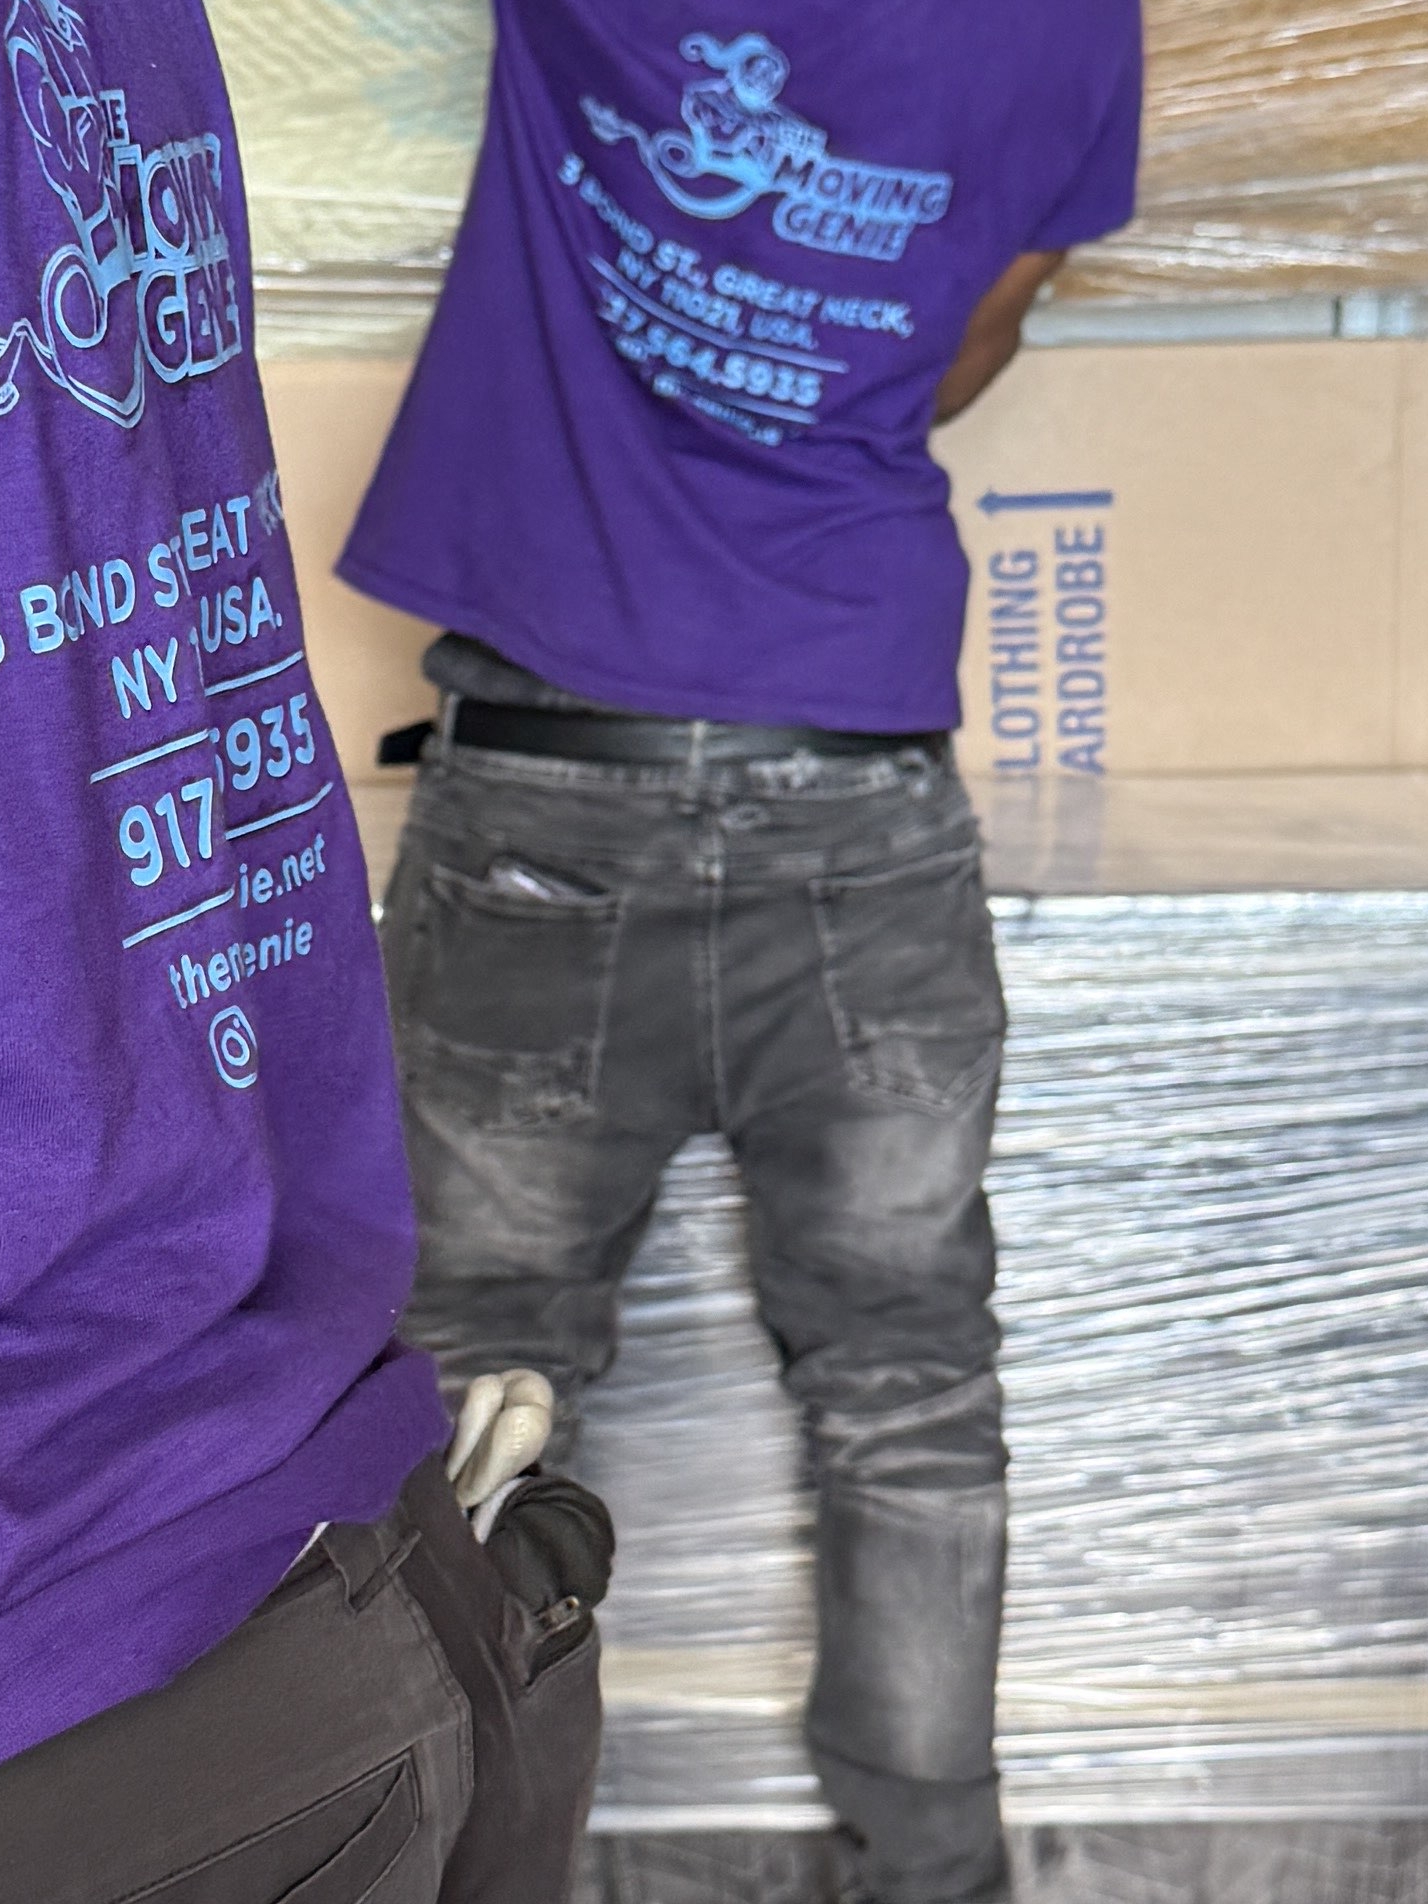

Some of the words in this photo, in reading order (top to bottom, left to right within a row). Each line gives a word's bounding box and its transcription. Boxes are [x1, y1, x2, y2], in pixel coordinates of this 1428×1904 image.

[770, 152, 948, 220] MOVING
[780, 200, 906, 256] GENIE
[111, 637, 179, 720] NY
[200, 576, 283, 653] USA.
[987, 549, 1042, 771] LOTHING
[1053, 524, 1107, 777] ARDROBE
[118, 777, 213, 887] 917
